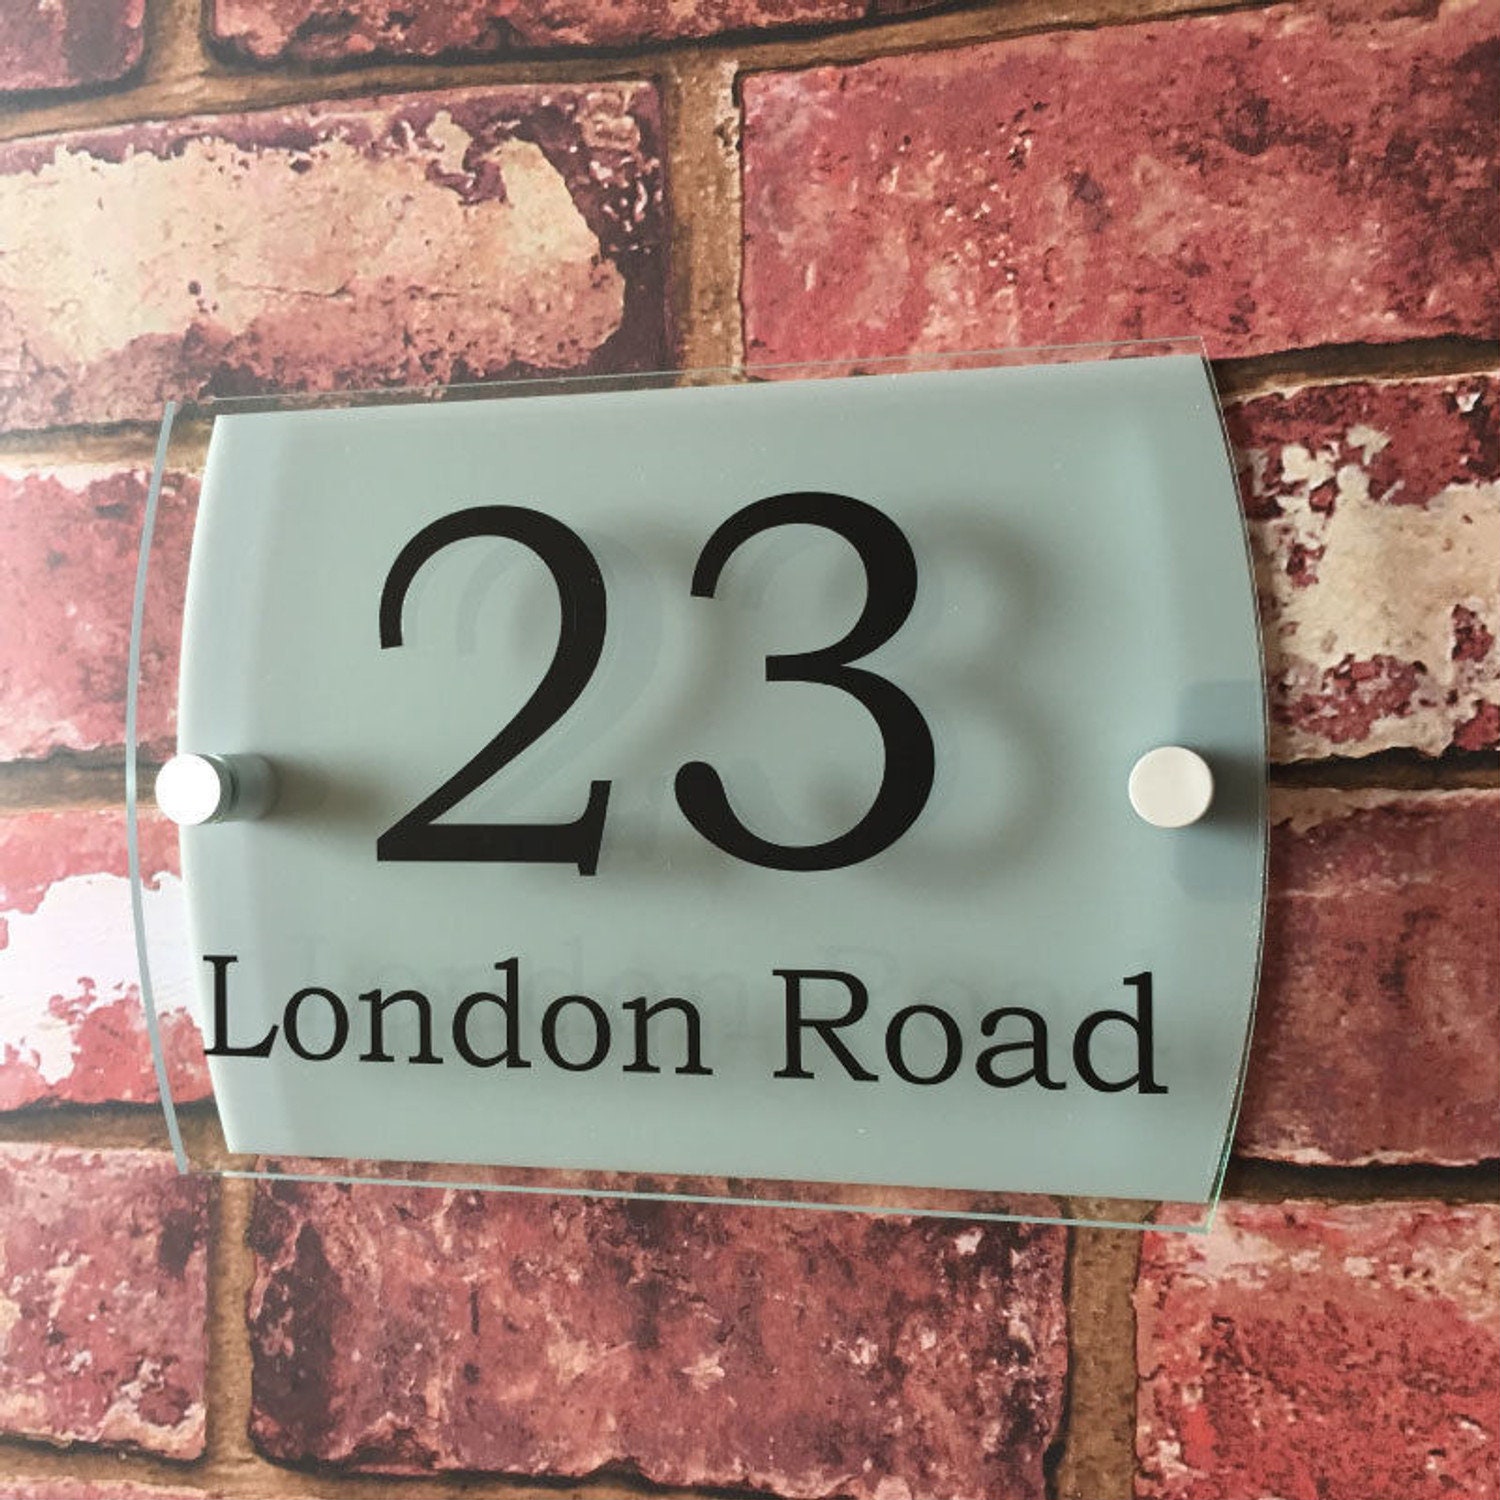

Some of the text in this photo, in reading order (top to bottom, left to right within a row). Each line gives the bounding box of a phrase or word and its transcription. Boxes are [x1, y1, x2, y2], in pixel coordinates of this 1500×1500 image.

[377, 491, 936, 876] 23
[202, 956, 1168, 1096] London Road
